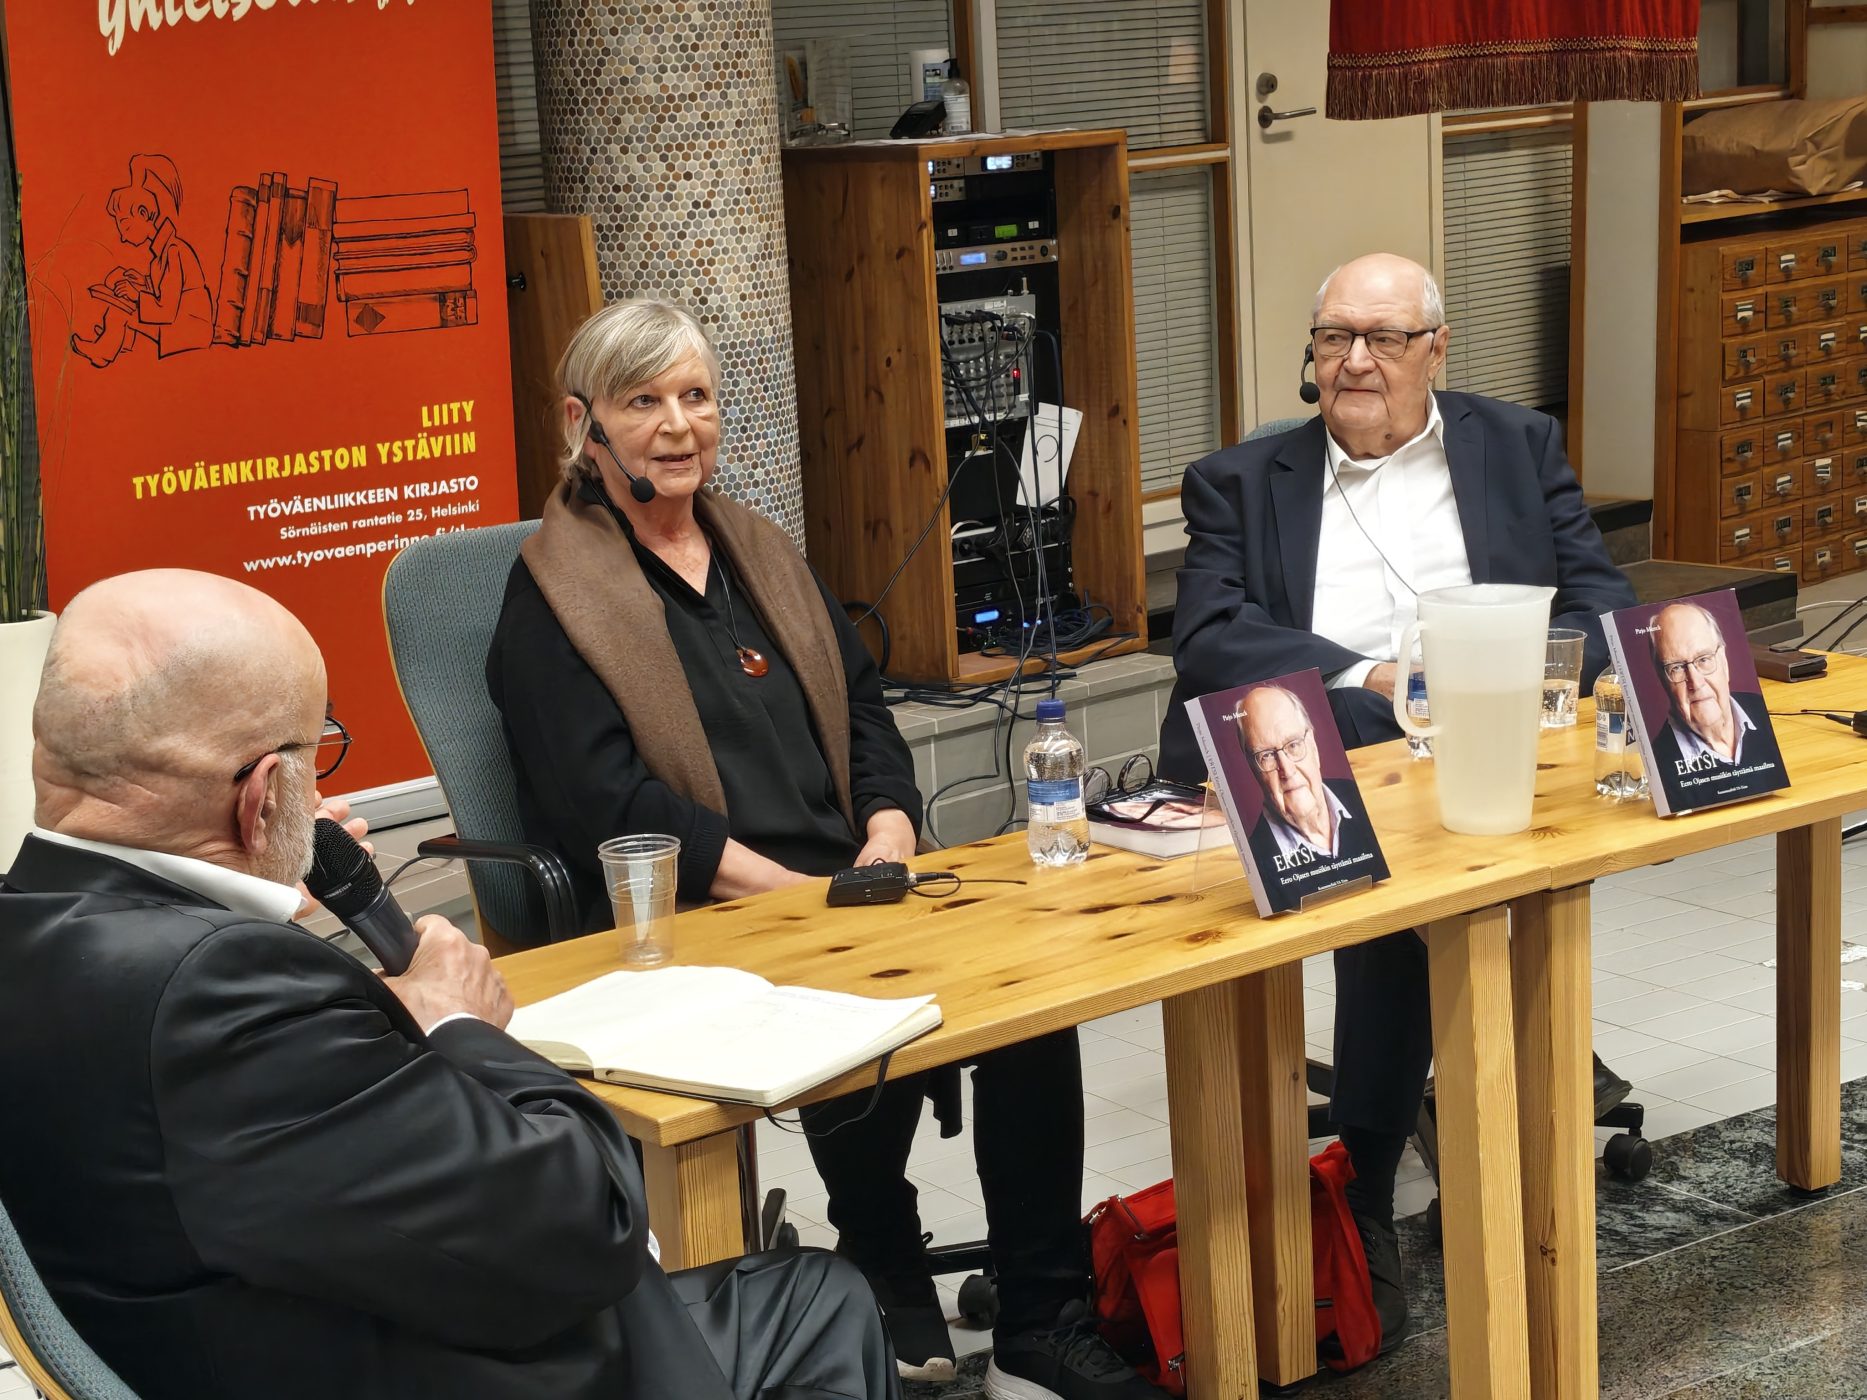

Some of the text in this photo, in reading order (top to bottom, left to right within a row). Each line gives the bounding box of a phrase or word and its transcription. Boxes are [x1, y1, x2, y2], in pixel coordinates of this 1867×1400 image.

[422, 401, 475, 428] LIITY
[133, 432, 476, 500] TYÖVÄENKIRJASTON YSTÄVIIN
[247, 475, 479, 521] TYÖVÄENLIIKKEEN KIRJASTO
[280, 501, 480, 540] Sörnäisten rantatie 25, Helsinki
[1675, 754, 1717, 776] ERTSI
[1273, 847, 1316, 872] ERTSI
